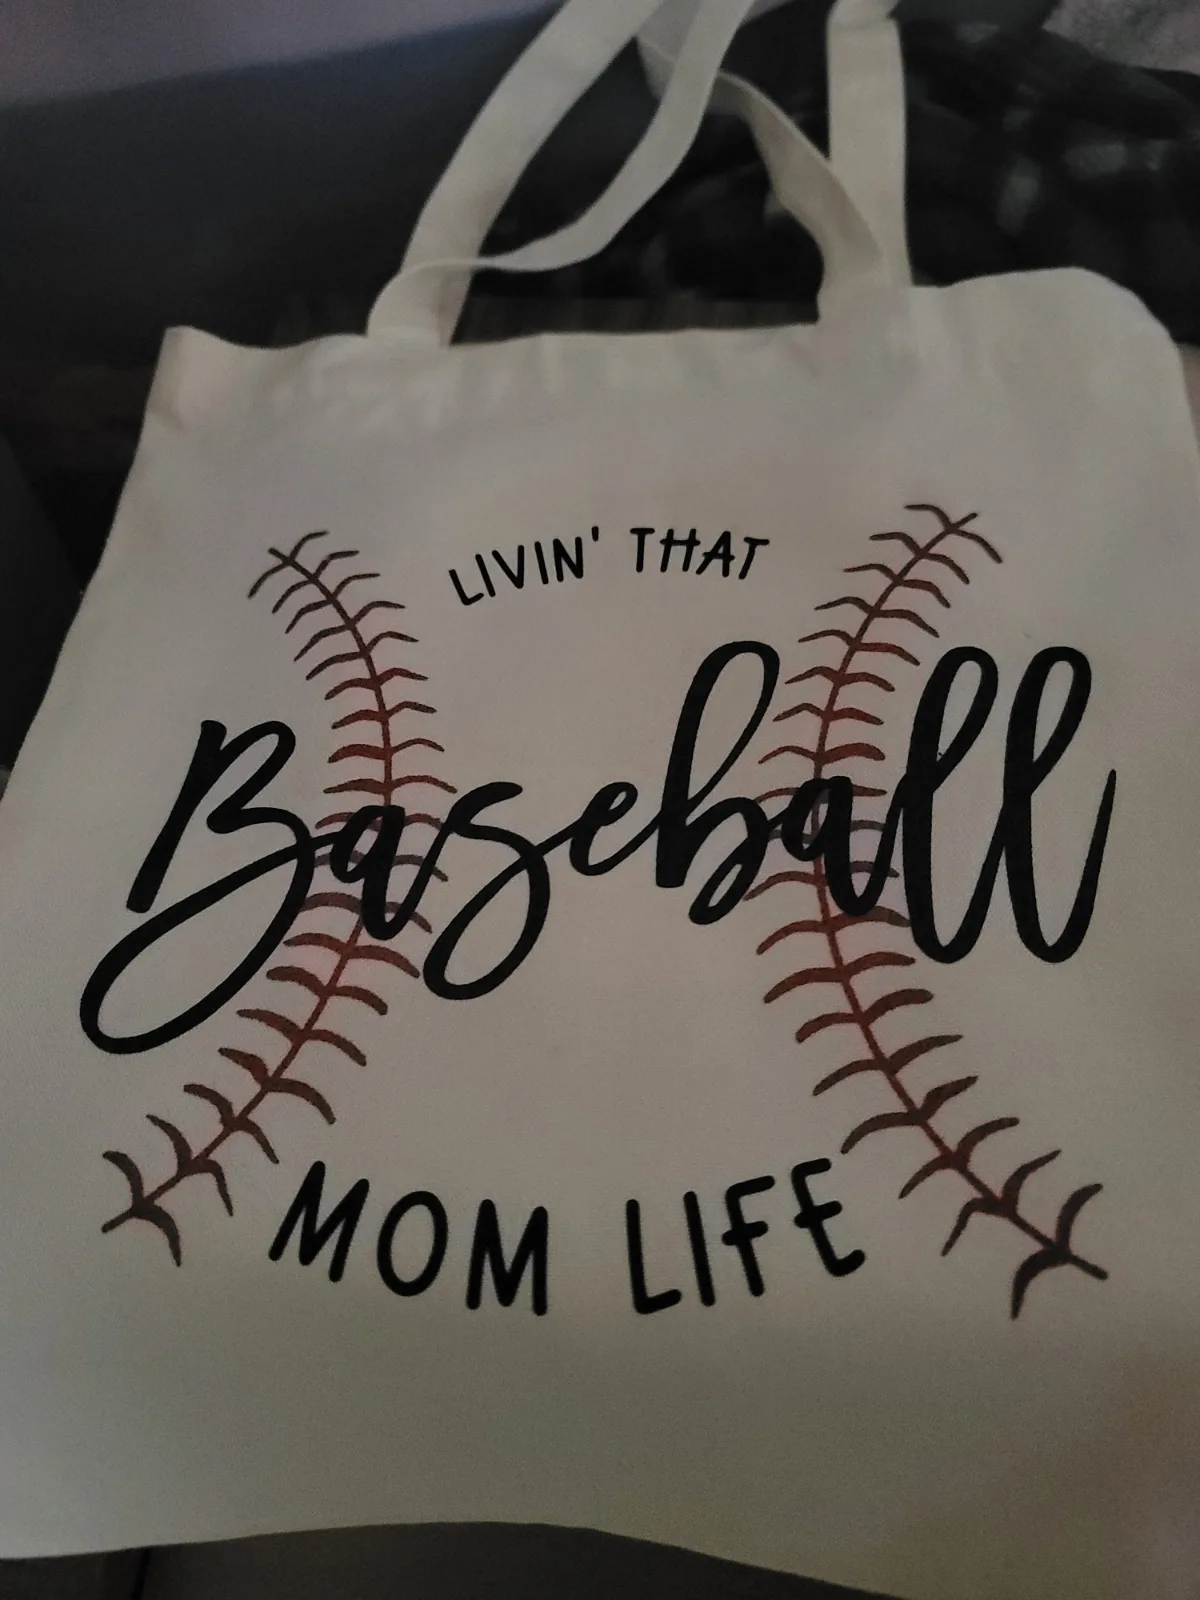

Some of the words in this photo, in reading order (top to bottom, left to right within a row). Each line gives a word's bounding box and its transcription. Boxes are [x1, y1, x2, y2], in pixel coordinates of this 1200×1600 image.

[447, 525, 600, 606] LIVIN'
[629, 527, 770, 581] THAT
[79, 640, 1117, 1055] Baseball
[268, 1160, 549, 1317] MOM
[625, 1157, 867, 1316] LIFE
